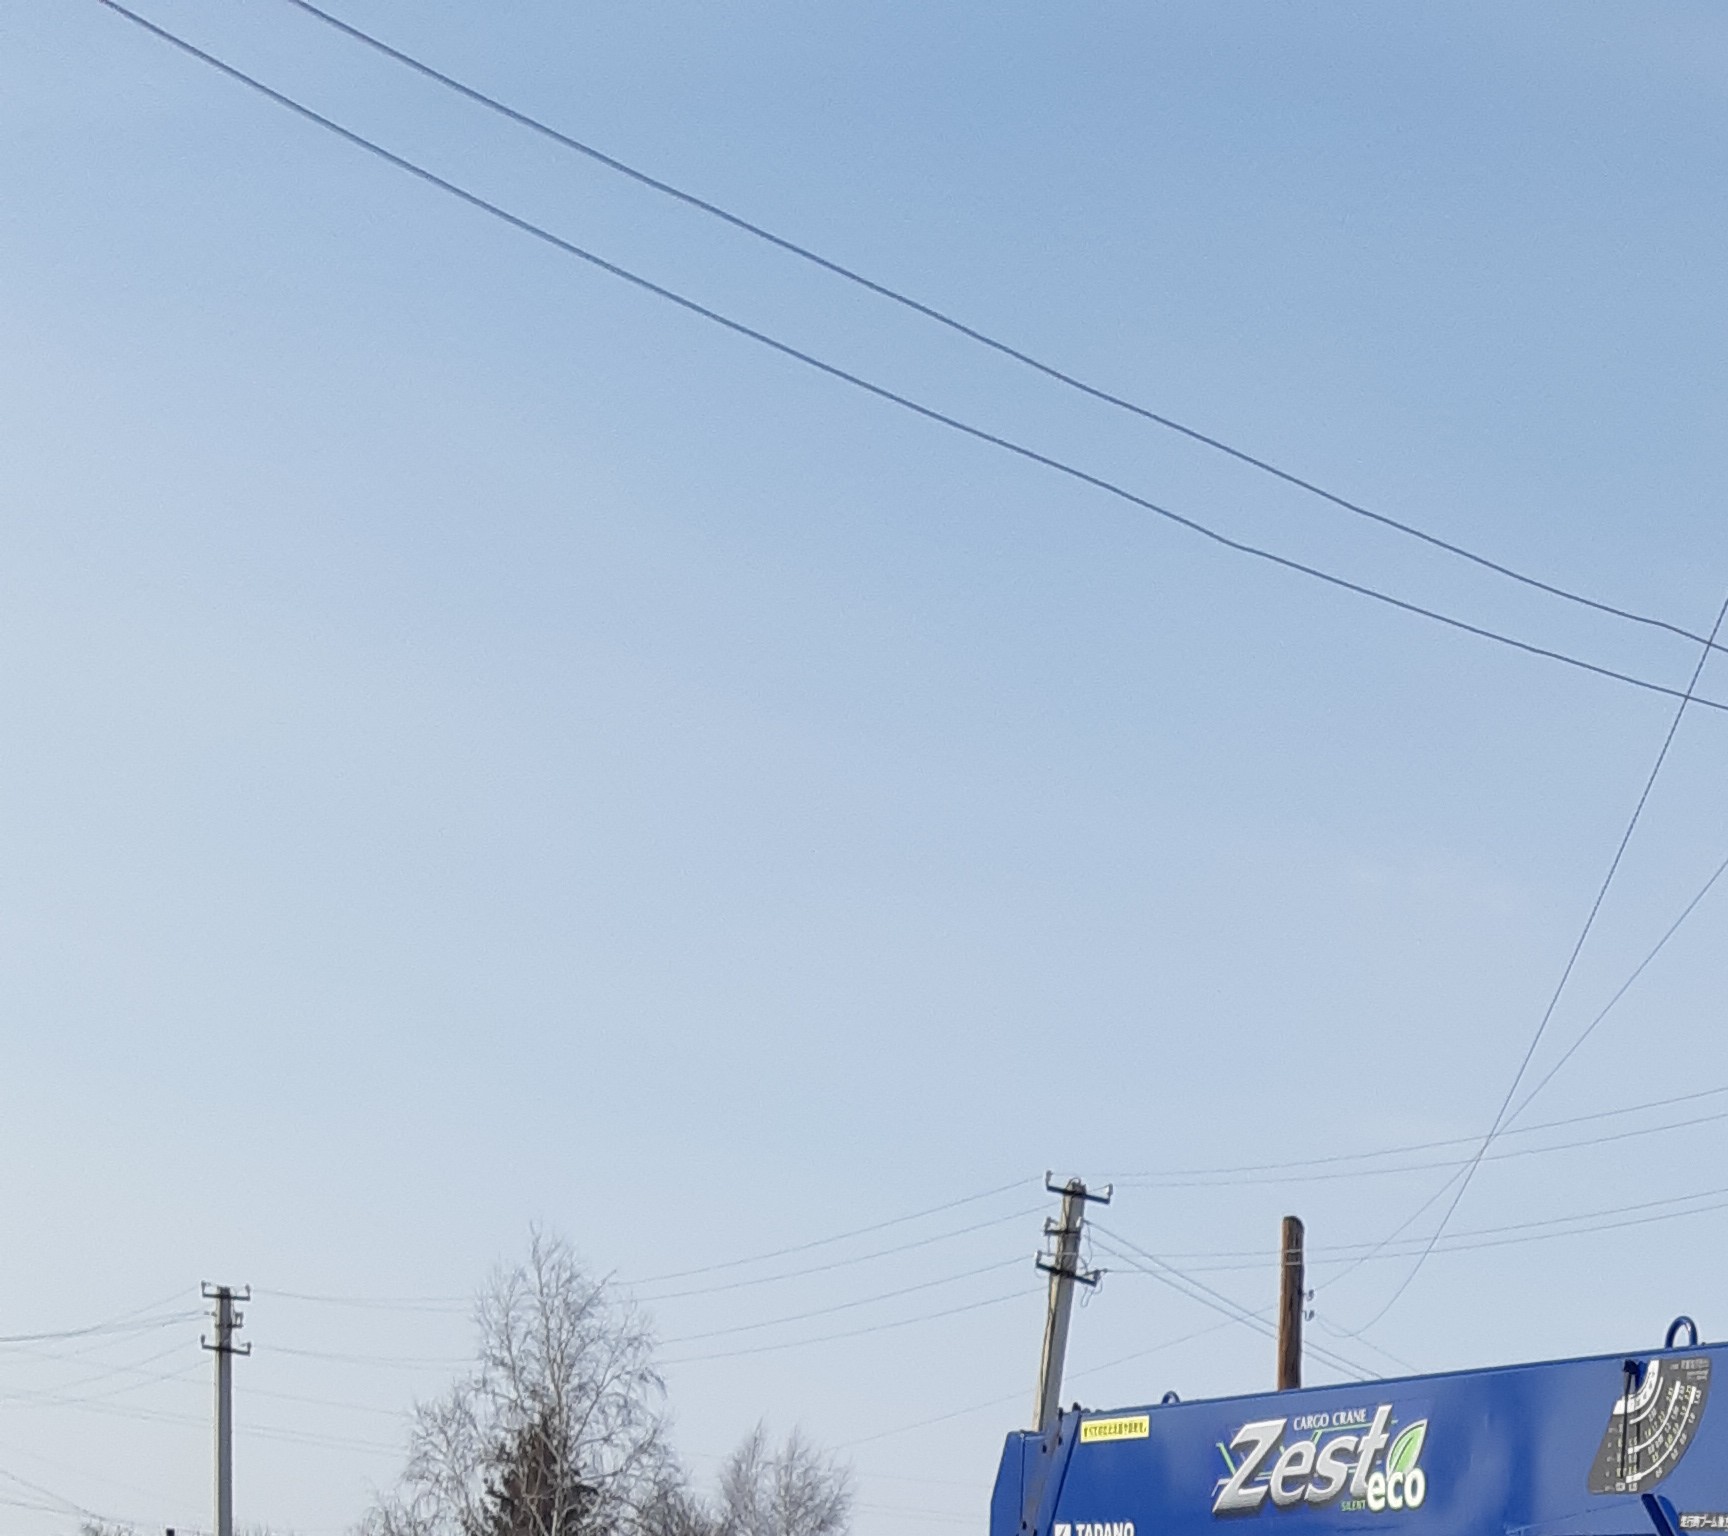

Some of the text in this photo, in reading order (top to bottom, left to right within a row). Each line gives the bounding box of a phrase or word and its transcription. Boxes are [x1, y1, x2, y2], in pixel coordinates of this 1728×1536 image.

[1293, 1408, 1367, 1431] CARGO CRANE
[1211, 1404, 1394, 1514] Zest
[1366, 1467, 1427, 1512] eco
